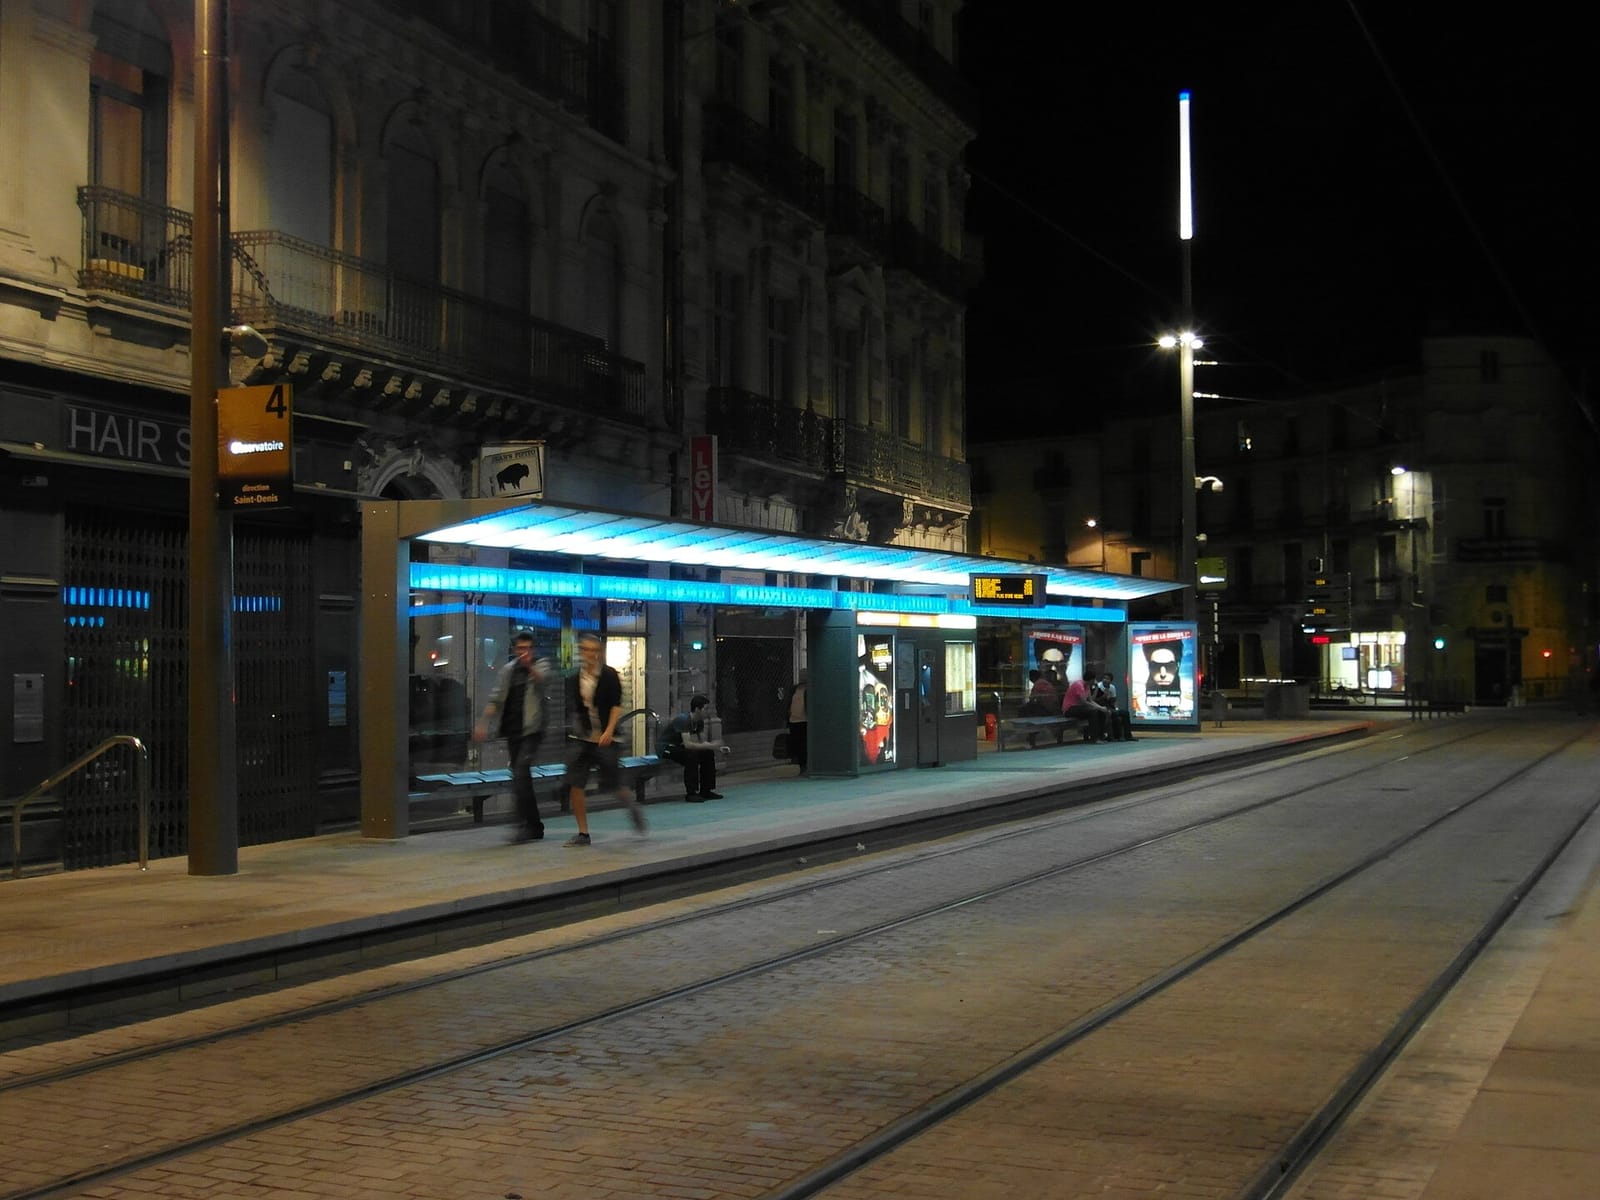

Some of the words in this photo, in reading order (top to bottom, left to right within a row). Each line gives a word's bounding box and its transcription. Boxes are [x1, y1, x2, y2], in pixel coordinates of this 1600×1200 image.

[266, 385, 287, 418] 4
[69, 408, 163, 462] HAIR
[230, 440, 284, 454] ervatoire
[233, 492, 279, 506] Saint-Denis
